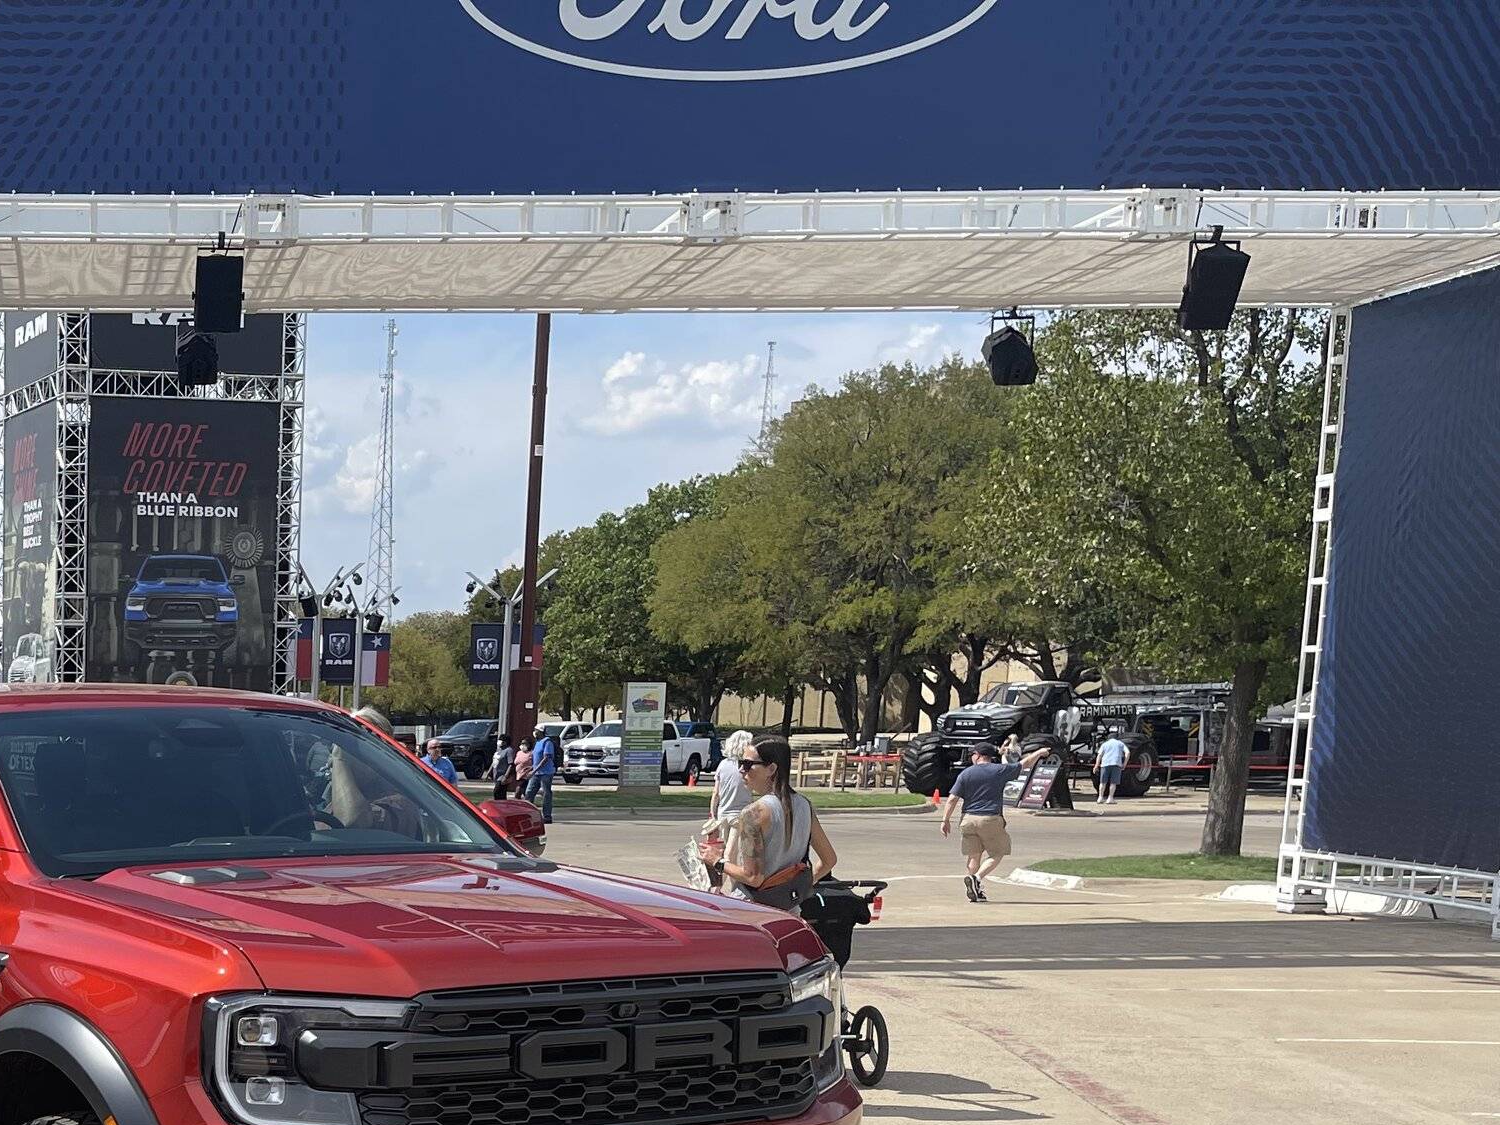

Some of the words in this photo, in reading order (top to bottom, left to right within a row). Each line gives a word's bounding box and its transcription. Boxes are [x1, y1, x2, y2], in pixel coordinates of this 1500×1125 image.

[14, 311, 48, 349] RAM
[122, 421, 210, 460] MORE
[122, 459, 249, 498] COVETED
[137, 491, 183, 504] THAN
[185, 492, 198, 504] A
[136, 505, 176, 517] BLUE
[179, 506, 239, 518] RIBBON
[1079, 704, 1134, 718] RAMINATOR
[20, 756, 36, 771] TEX
[378, 1010, 834, 1090] FORD
